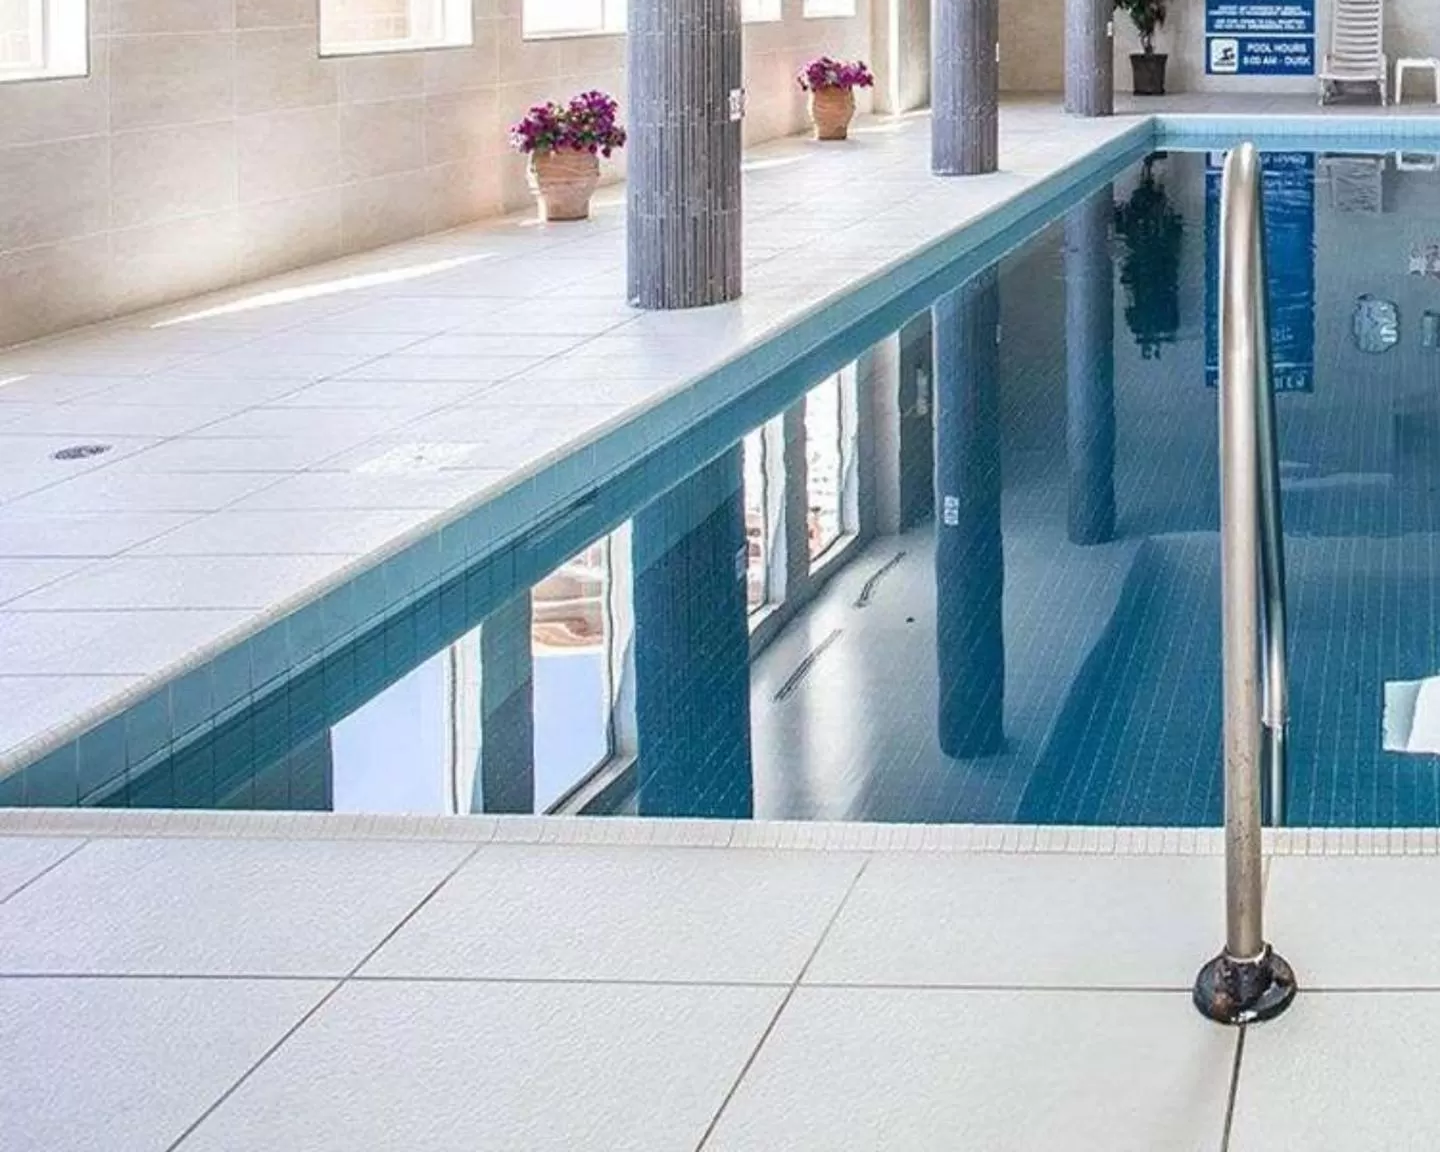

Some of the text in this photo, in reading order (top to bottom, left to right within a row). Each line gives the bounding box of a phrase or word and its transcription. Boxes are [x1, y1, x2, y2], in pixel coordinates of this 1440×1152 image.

[1247, 43, 1306, 53] POOL HOURS
[1263, 56, 1277, 65] AM
[1284, 56, 1311, 66] DUSK
